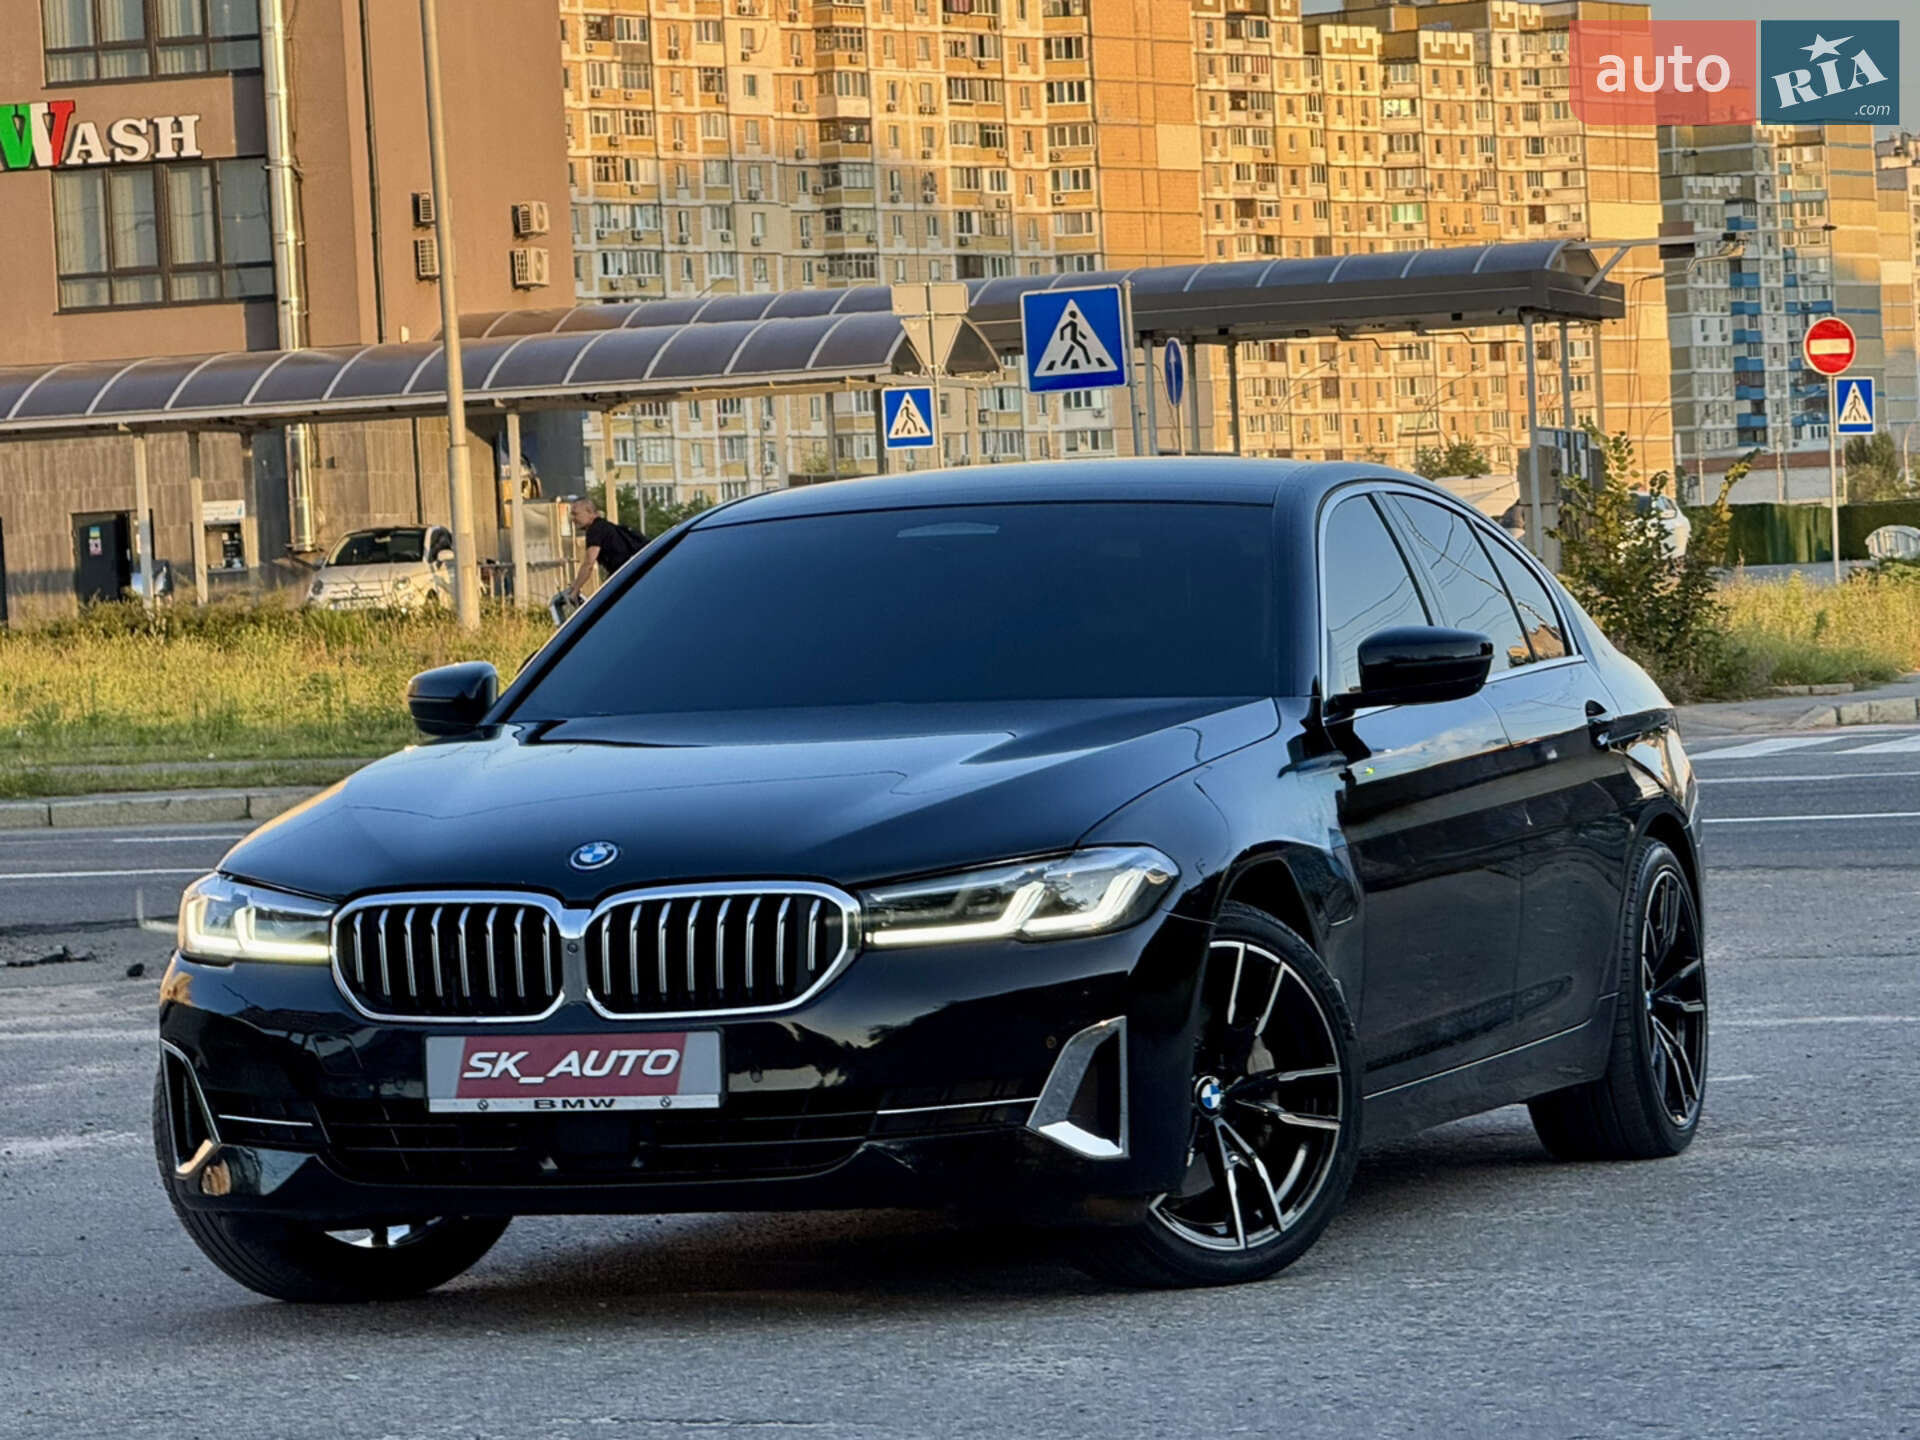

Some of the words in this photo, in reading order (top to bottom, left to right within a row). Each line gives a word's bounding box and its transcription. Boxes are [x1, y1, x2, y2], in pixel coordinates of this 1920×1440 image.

[0, 100, 202, 168] WASH
[462, 1049, 680, 1084] SK_AUTO
[534, 1098, 616, 1110] BMW
